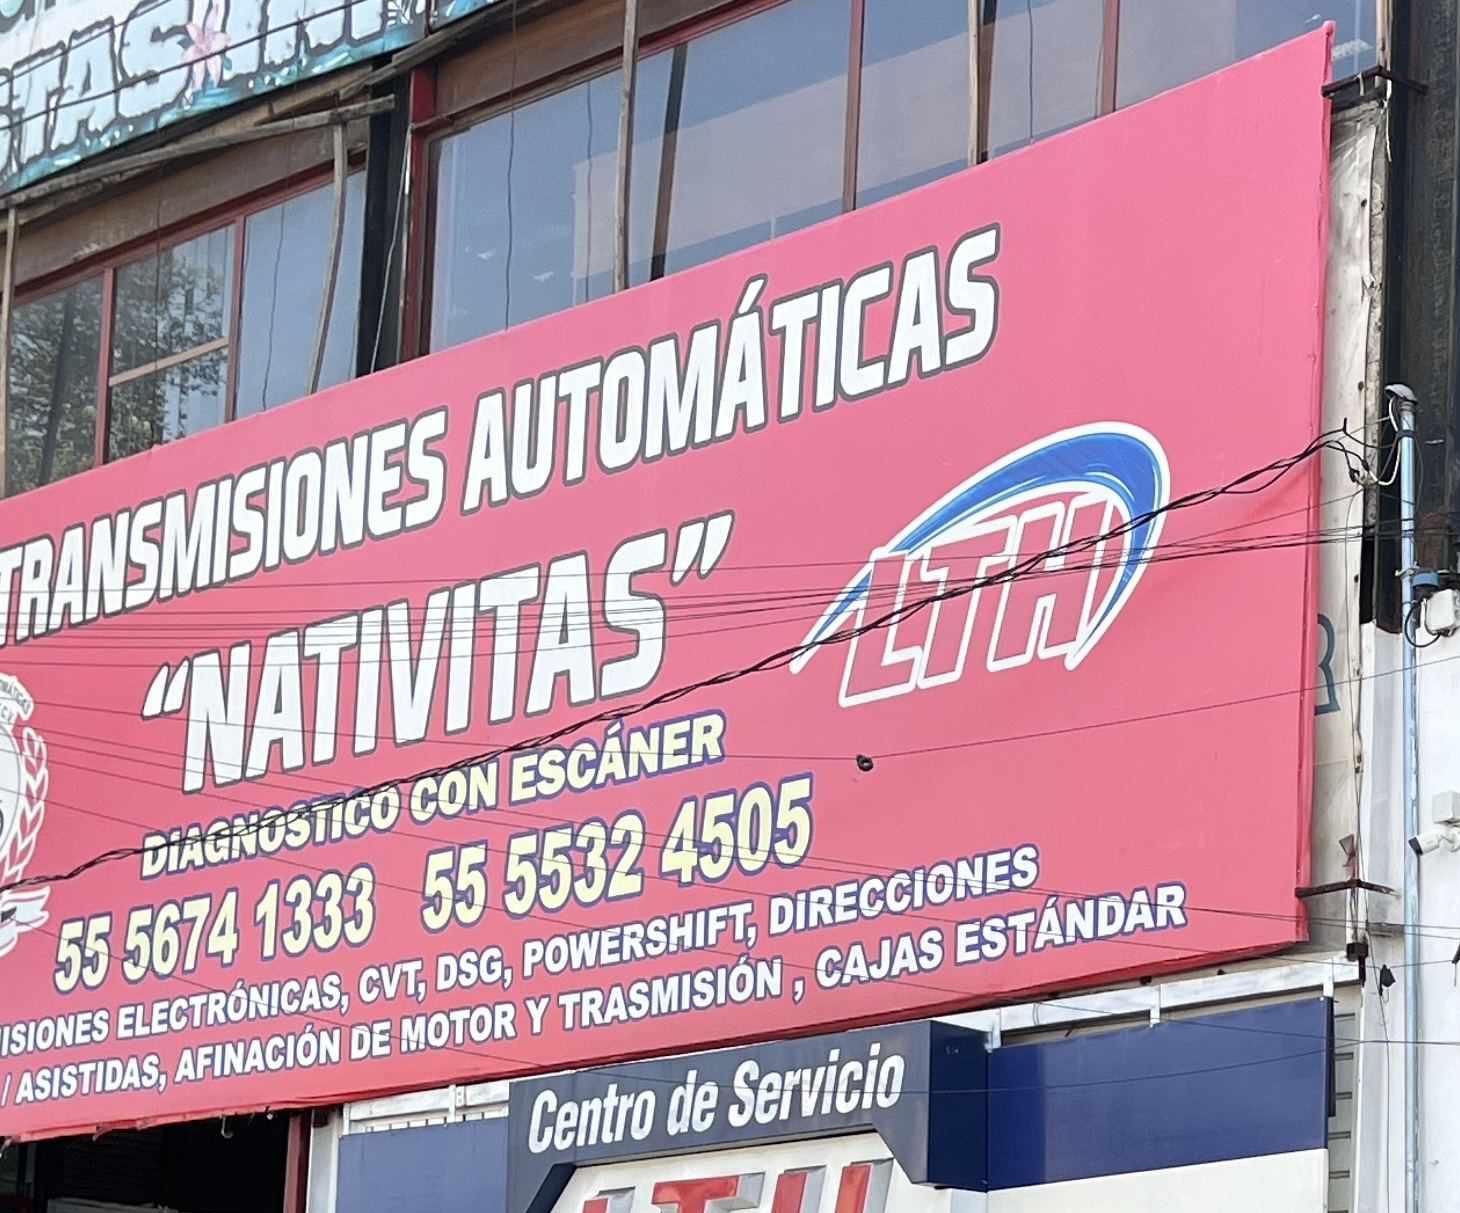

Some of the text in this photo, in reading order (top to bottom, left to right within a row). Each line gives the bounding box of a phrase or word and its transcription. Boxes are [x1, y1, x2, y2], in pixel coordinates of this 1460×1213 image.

[0, 224, 1001, 648] TRANSMISIONES AUTOMÁTICAS
[141, 511, 735, 793] “NATIVITAS”
[838, 490, 1120, 708] LTH
[409, 755, 500, 826] CON
[509, 709, 726, 802] ESCÁNER
[0, 844, 1041, 1058] ISIONES ELECTRÓNICAS, CVT, DSG, POWERSHIFT, DIRECCIONES
[54, 773, 814, 994] 55 5674 1333 55 5532 4505
[14, 1053, 166, 1105] ASISTIDAS,
[175, 1025, 343, 1086] AFINACIÓN
[350, 1020, 392, 1058] DE
[399, 1004, 517, 1055] MOTOR
[529, 997, 552, 1035] Y
[814, 928, 945, 990] CAJAS
[955, 882, 1189, 966] ESTÁNDAR
[528, 1042, 906, 1155] Centro de Servicio
